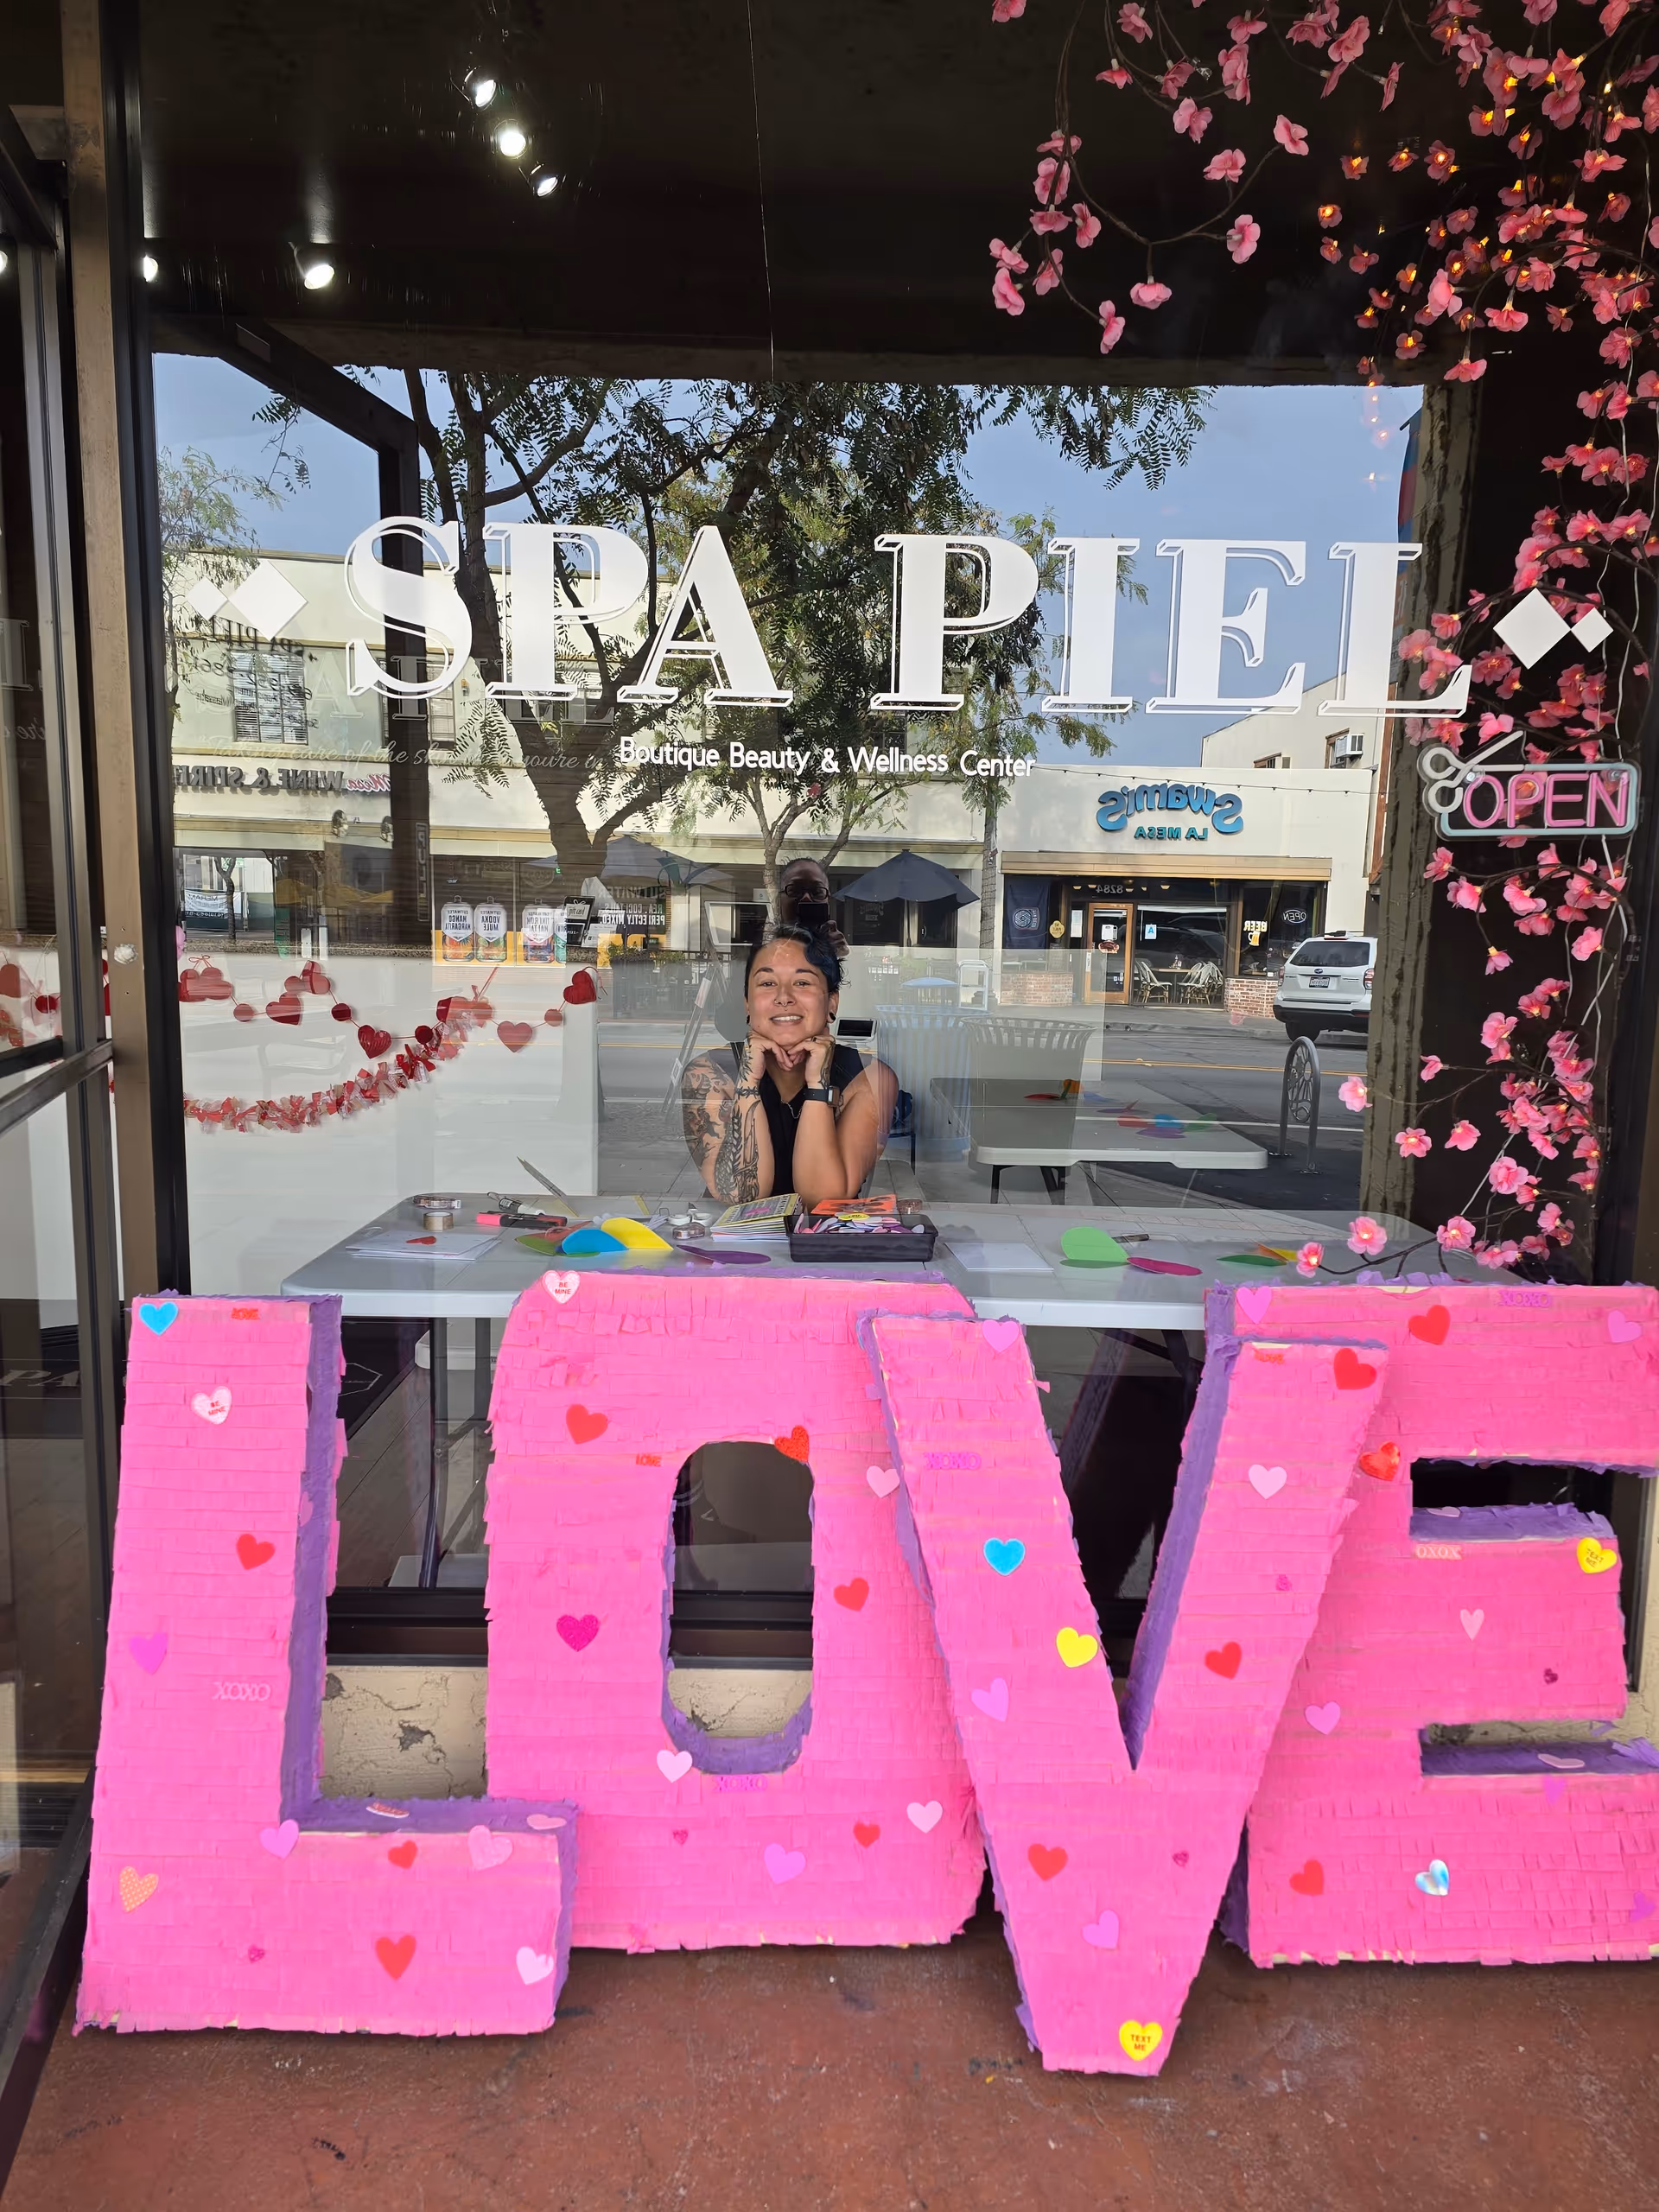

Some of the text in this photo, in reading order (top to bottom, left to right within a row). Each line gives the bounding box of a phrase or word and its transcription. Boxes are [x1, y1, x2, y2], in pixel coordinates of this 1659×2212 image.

[345, 515, 1473, 719] SPA PIEL
[374, 741, 408, 764] the
[620, 735, 1037, 777] Boutique Beauty & Wellness Center
[1463, 771, 1630, 829] OPEN
[208, 1405, 226, 1416] MINE
[635, 1452, 663, 1468] LOVE
[923, 1452, 982, 1470] XOXO
[211, 1681, 271, 1701] XOXO
[714, 1774, 768, 1791] XOXO
[1130, 2033, 1151, 2044] TEXT
[1134, 2043, 1147, 2051] ME
